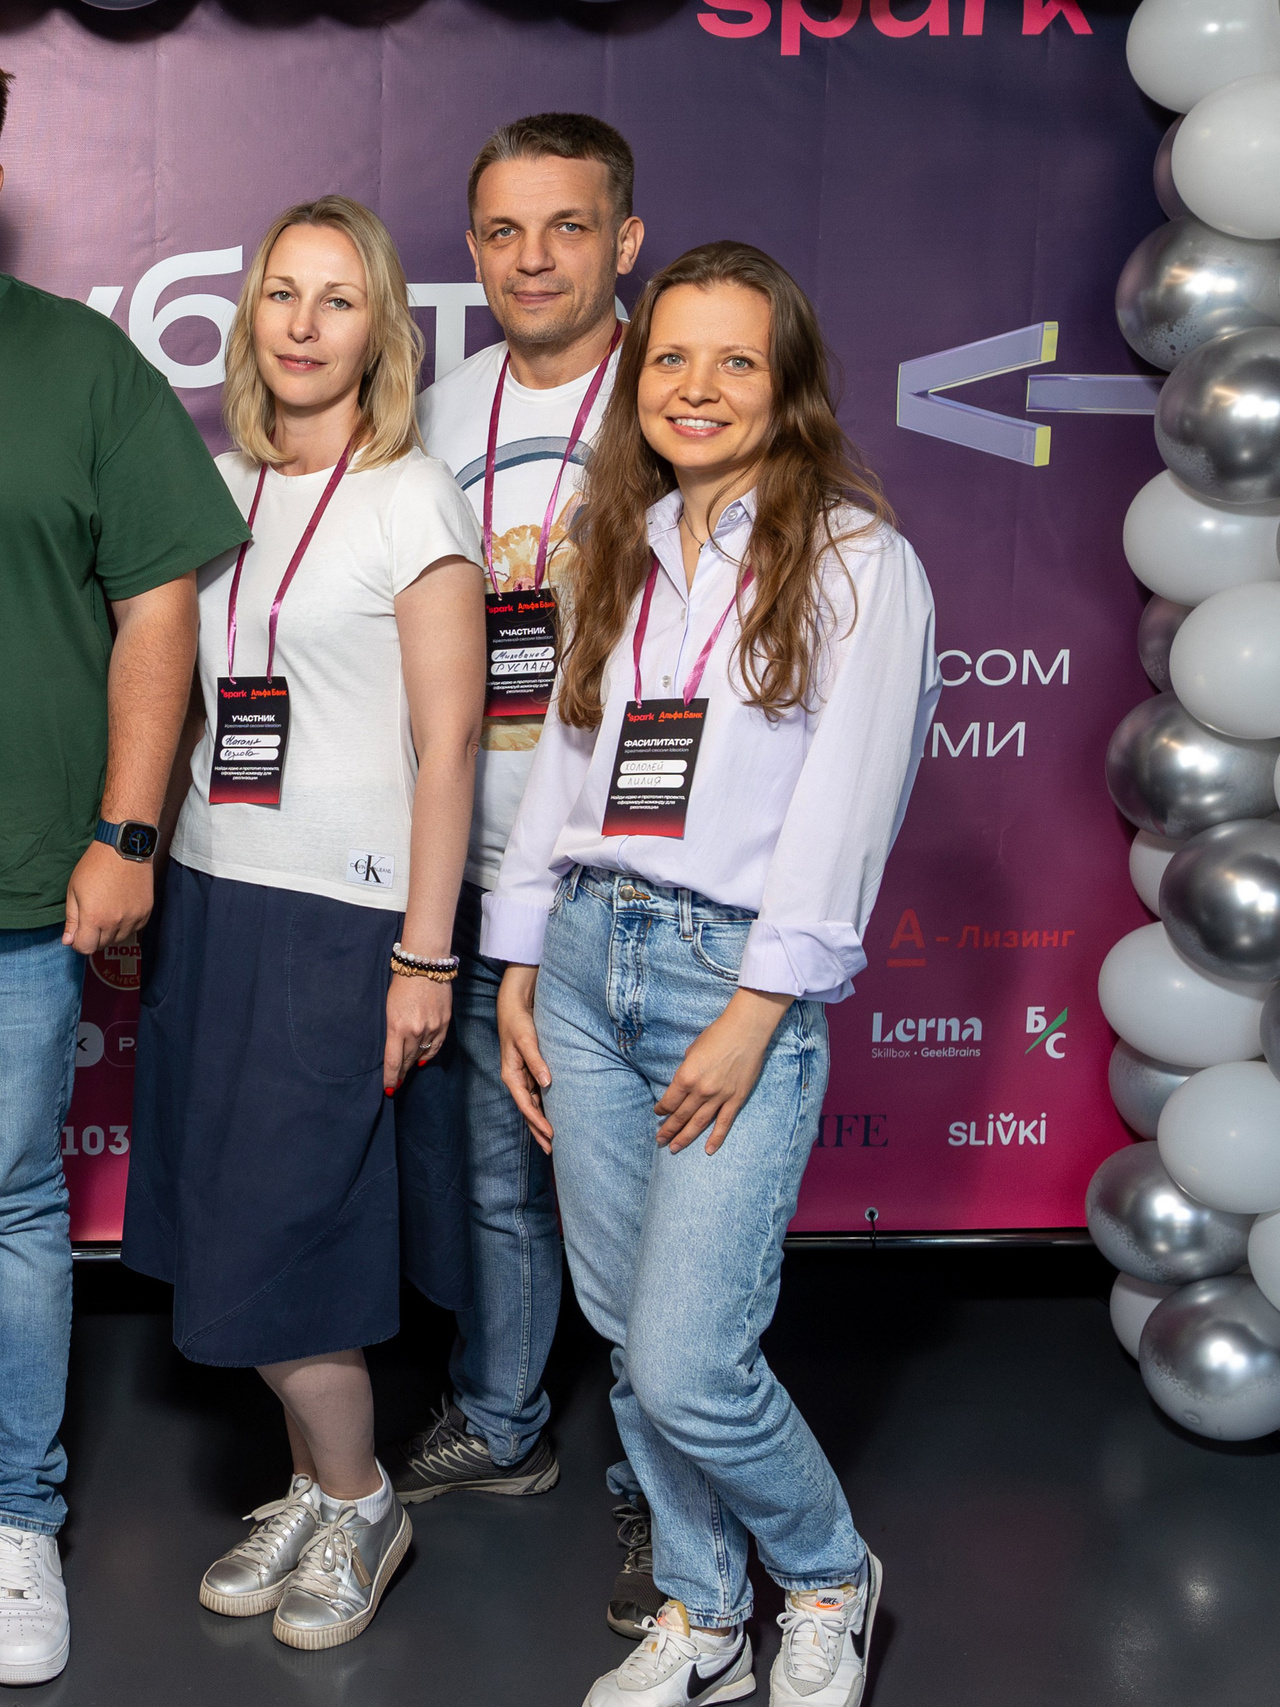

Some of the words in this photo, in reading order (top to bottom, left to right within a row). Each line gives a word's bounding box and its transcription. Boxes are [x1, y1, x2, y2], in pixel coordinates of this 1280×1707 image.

[500, 627, 546, 637] УЧАСТНИК
[496, 661, 549, 672] РУСЛАН
[624, 739, 693, 747] ФАСИЛИТАТОР
[957, 925, 1076, 949] Лизинг
[872, 1012, 982, 1043] Lerna
[871, 1048, 910, 1058] Skillbox
[921, 1047, 980, 1058] GeekBrains
[62, 1125, 130, 1156] 103
